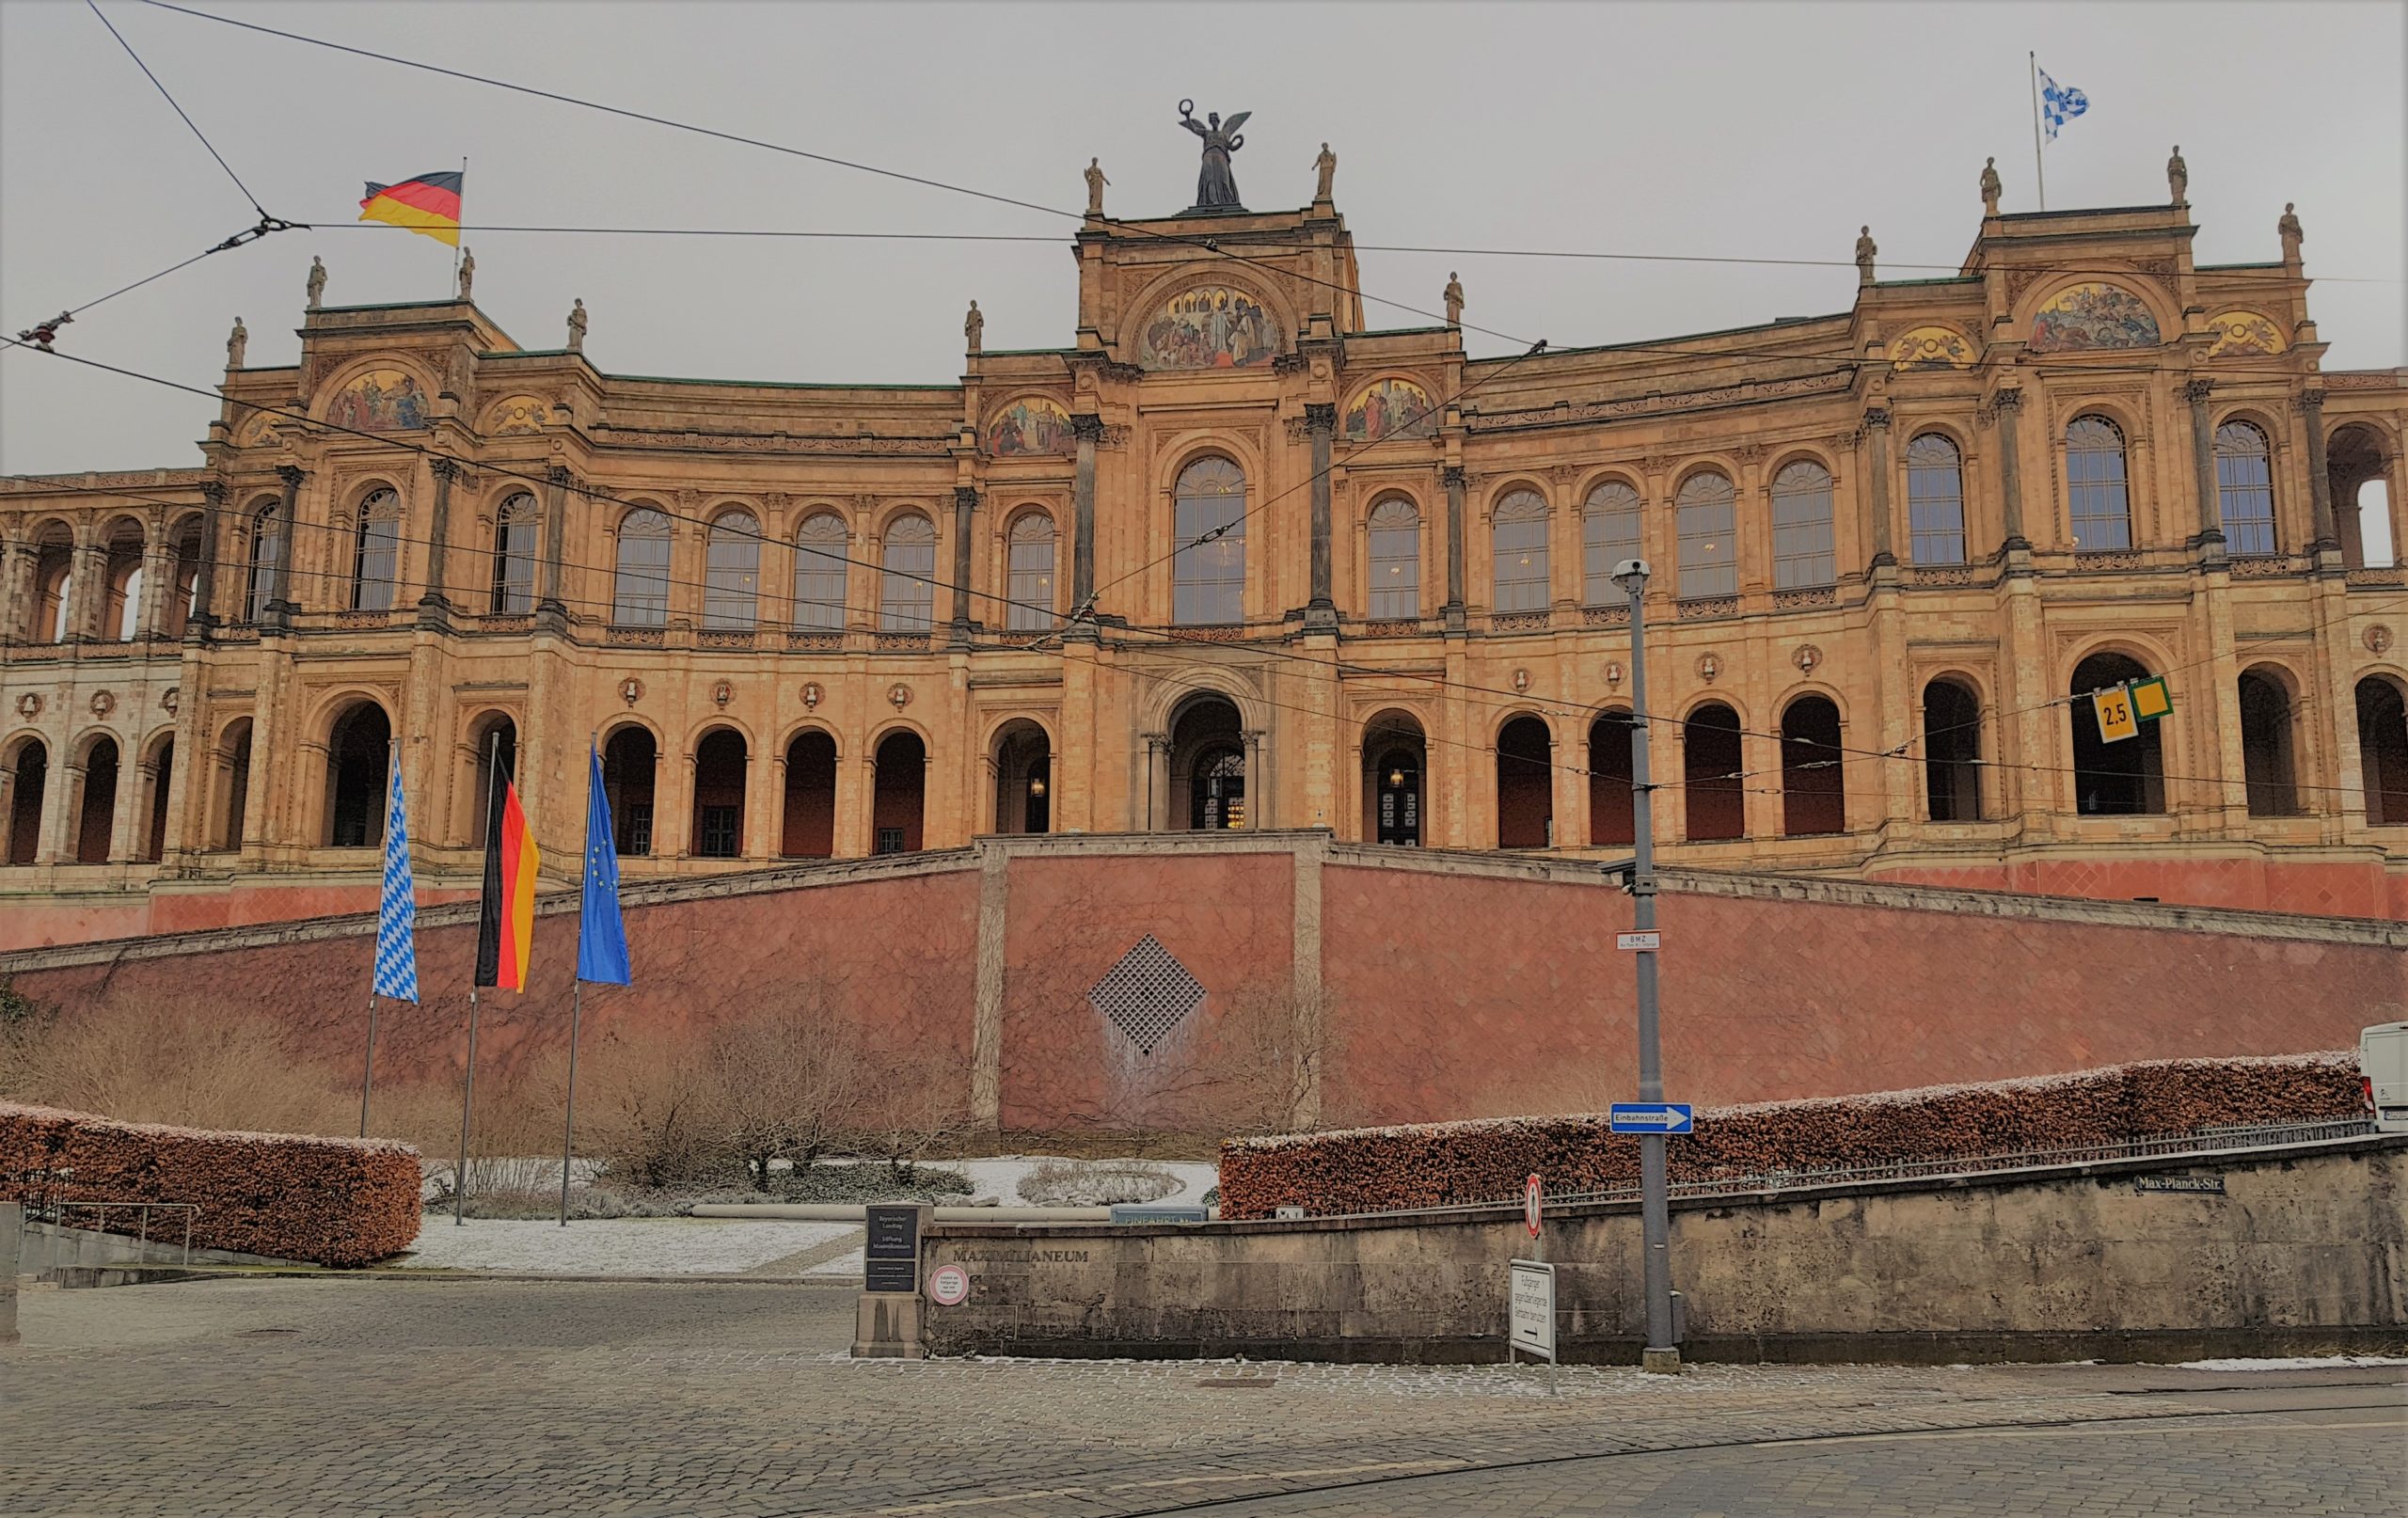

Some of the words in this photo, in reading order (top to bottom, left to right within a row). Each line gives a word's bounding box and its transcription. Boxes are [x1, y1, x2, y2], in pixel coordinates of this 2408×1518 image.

[2103, 703, 2127, 726] 2,5
[1615, 1114, 1669, 1122] Einbahnstraße
[2139, 1176, 2222, 1190] Max-Planck-Str.
[953, 1249, 1089, 1262] MAXIMILIANEUM
